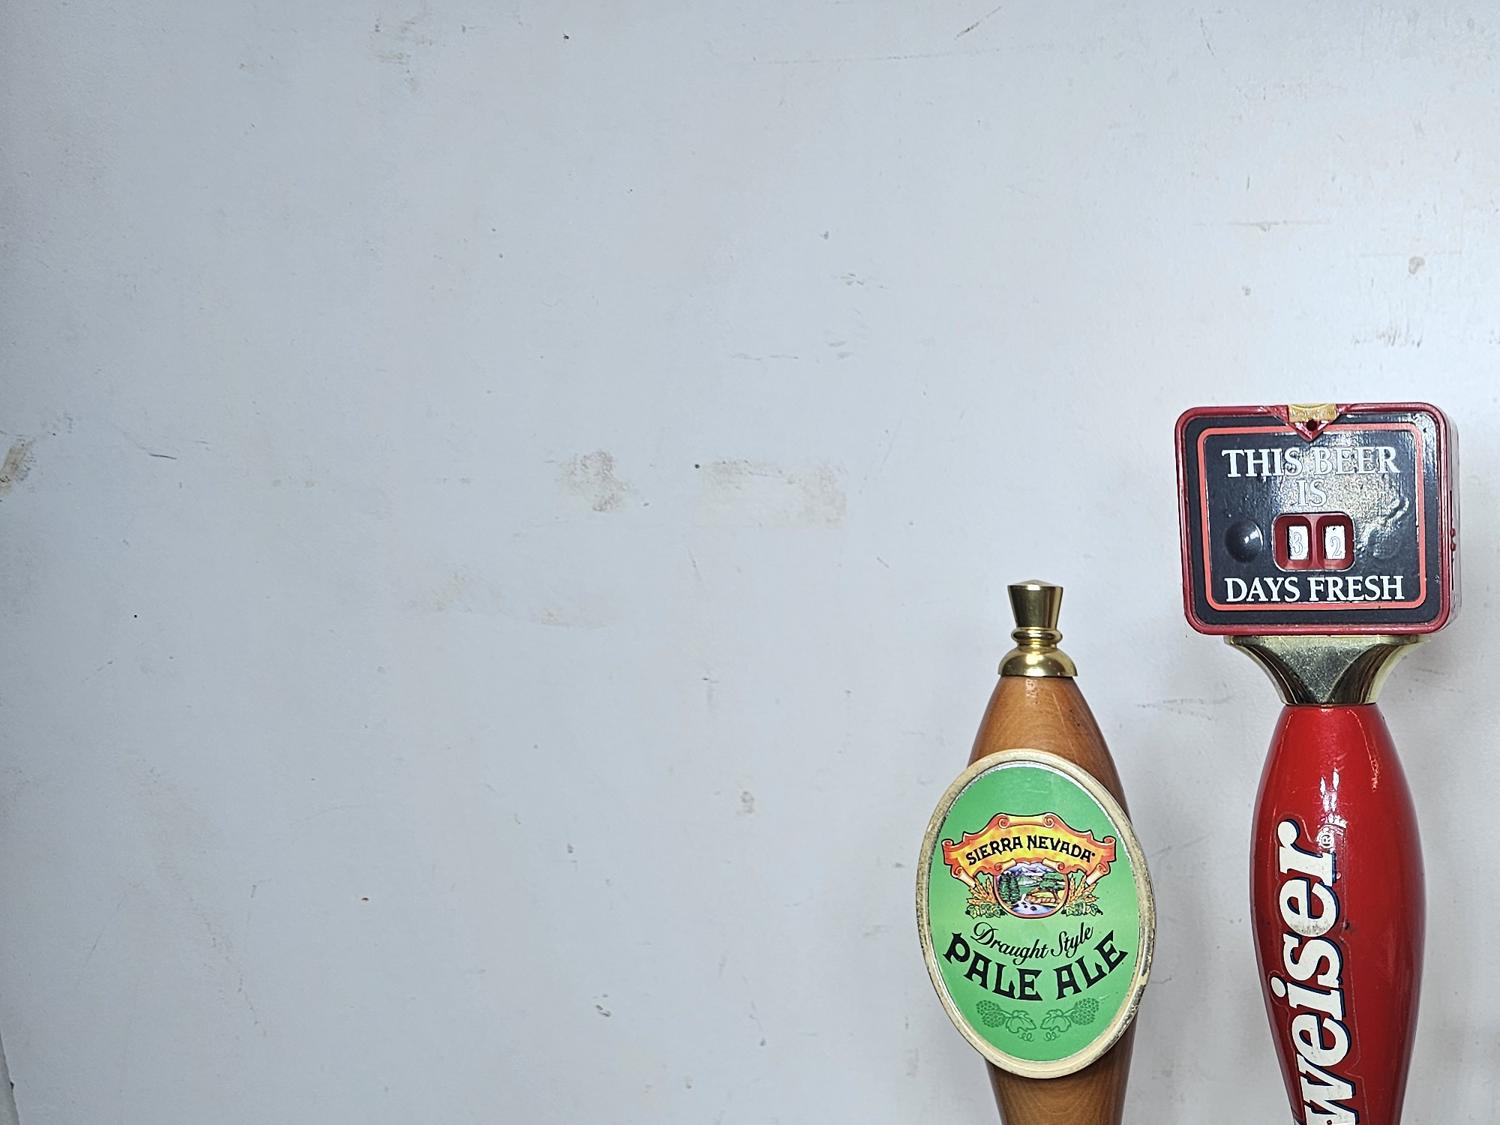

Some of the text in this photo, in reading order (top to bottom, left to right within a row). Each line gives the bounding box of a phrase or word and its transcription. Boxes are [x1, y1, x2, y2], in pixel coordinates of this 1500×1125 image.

[1221, 445, 1401, 478] THIS BEER
[1295, 479, 1328, 507] IS
[1224, 575, 1405, 602] DAYS FRESH
[965, 834, 1094, 866] SIERRA NEVADA
[970, 921, 1094, 965] Draught Style
[943, 929, 1129, 1001] PALE ALE
